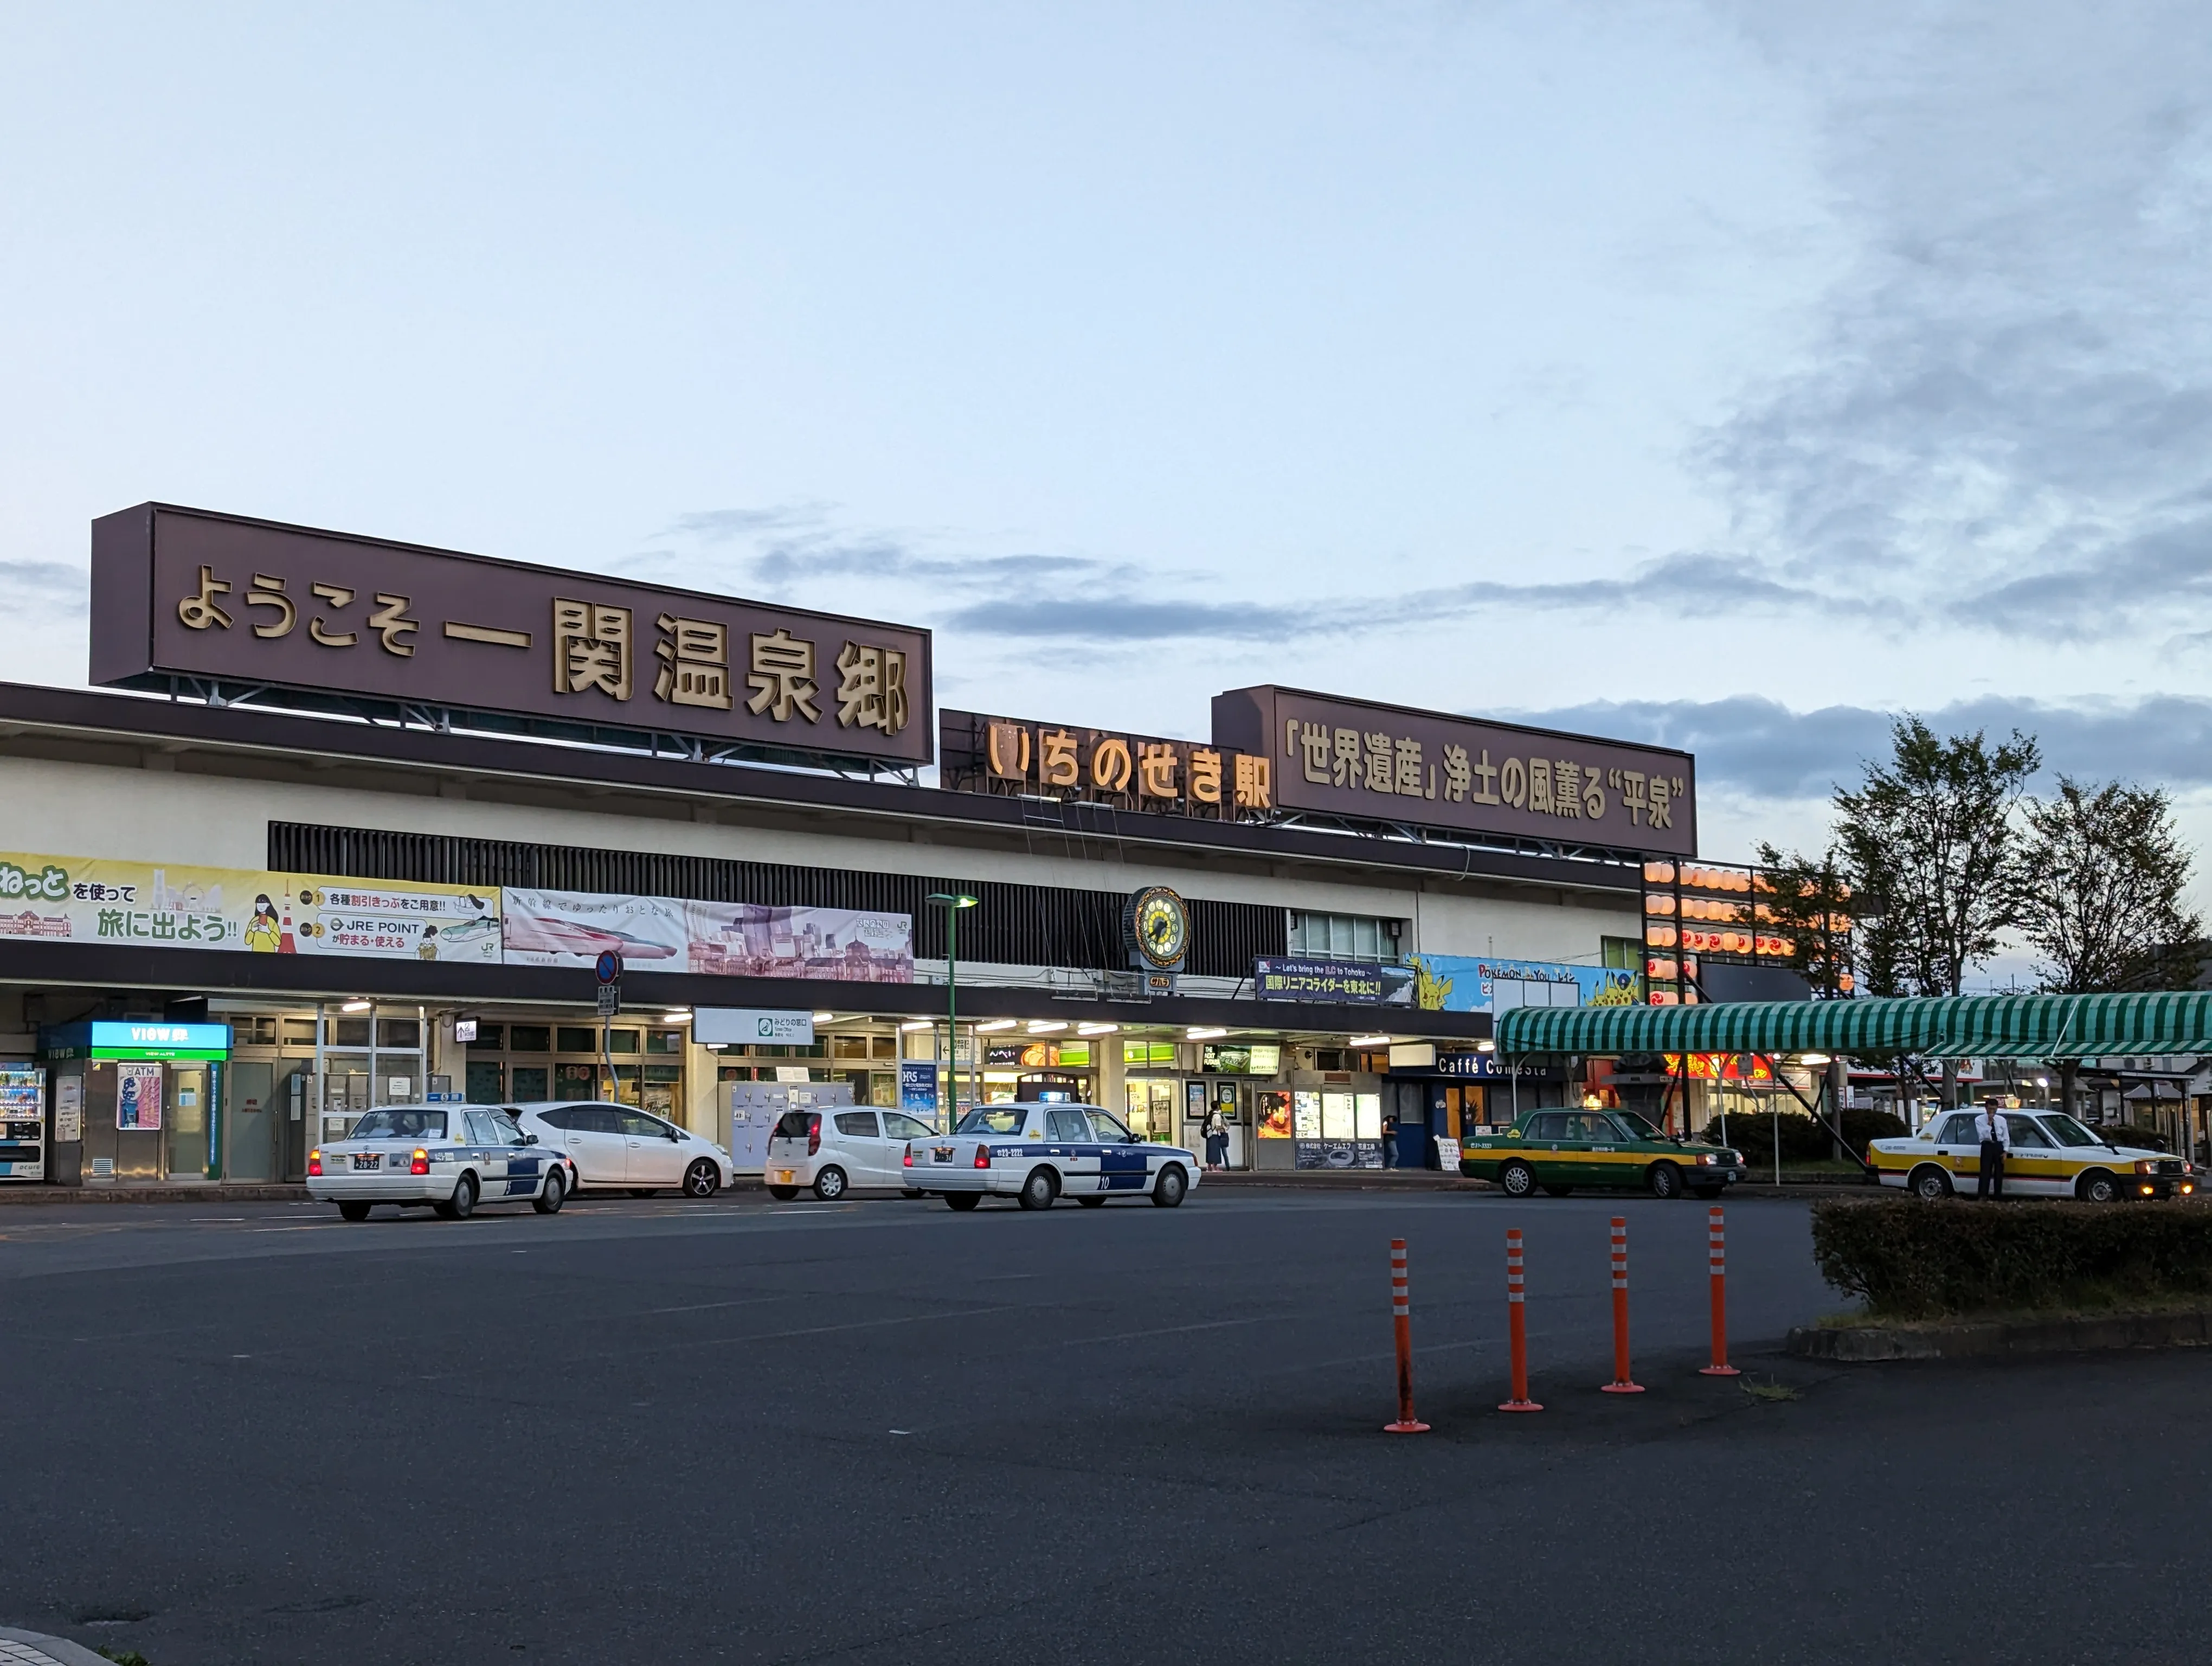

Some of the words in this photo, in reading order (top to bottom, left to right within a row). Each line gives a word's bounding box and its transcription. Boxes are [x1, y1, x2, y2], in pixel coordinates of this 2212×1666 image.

[178, 564, 909, 735] ようこそ一関温泉郷
[988, 727, 1271, 808] いちのせき駅
[73, 883, 136, 902] を使って
[316, 926, 320, 934] 2
[346, 920, 374, 932] JRE
[378, 922, 419, 934] POINT
[332, 934, 405, 948] が貯まる・使える
[481, 943, 494, 951] JR
[1282, 964, 1297, 972] Let's
[1298, 965, 1313, 976] bring
[1314, 965, 1323, 973] the
[1338, 967, 1343, 975] to
[1345, 967, 1365, 977] Tohoku
[774, 1018, 807, 1027] みどりの窓口
[134, 1067, 154, 1075] ATM
[1438, 1057, 1479, 1074] Caffé
[902, 1071, 917, 1082] HRS
[1101, 1176, 1109, 1190] 10
